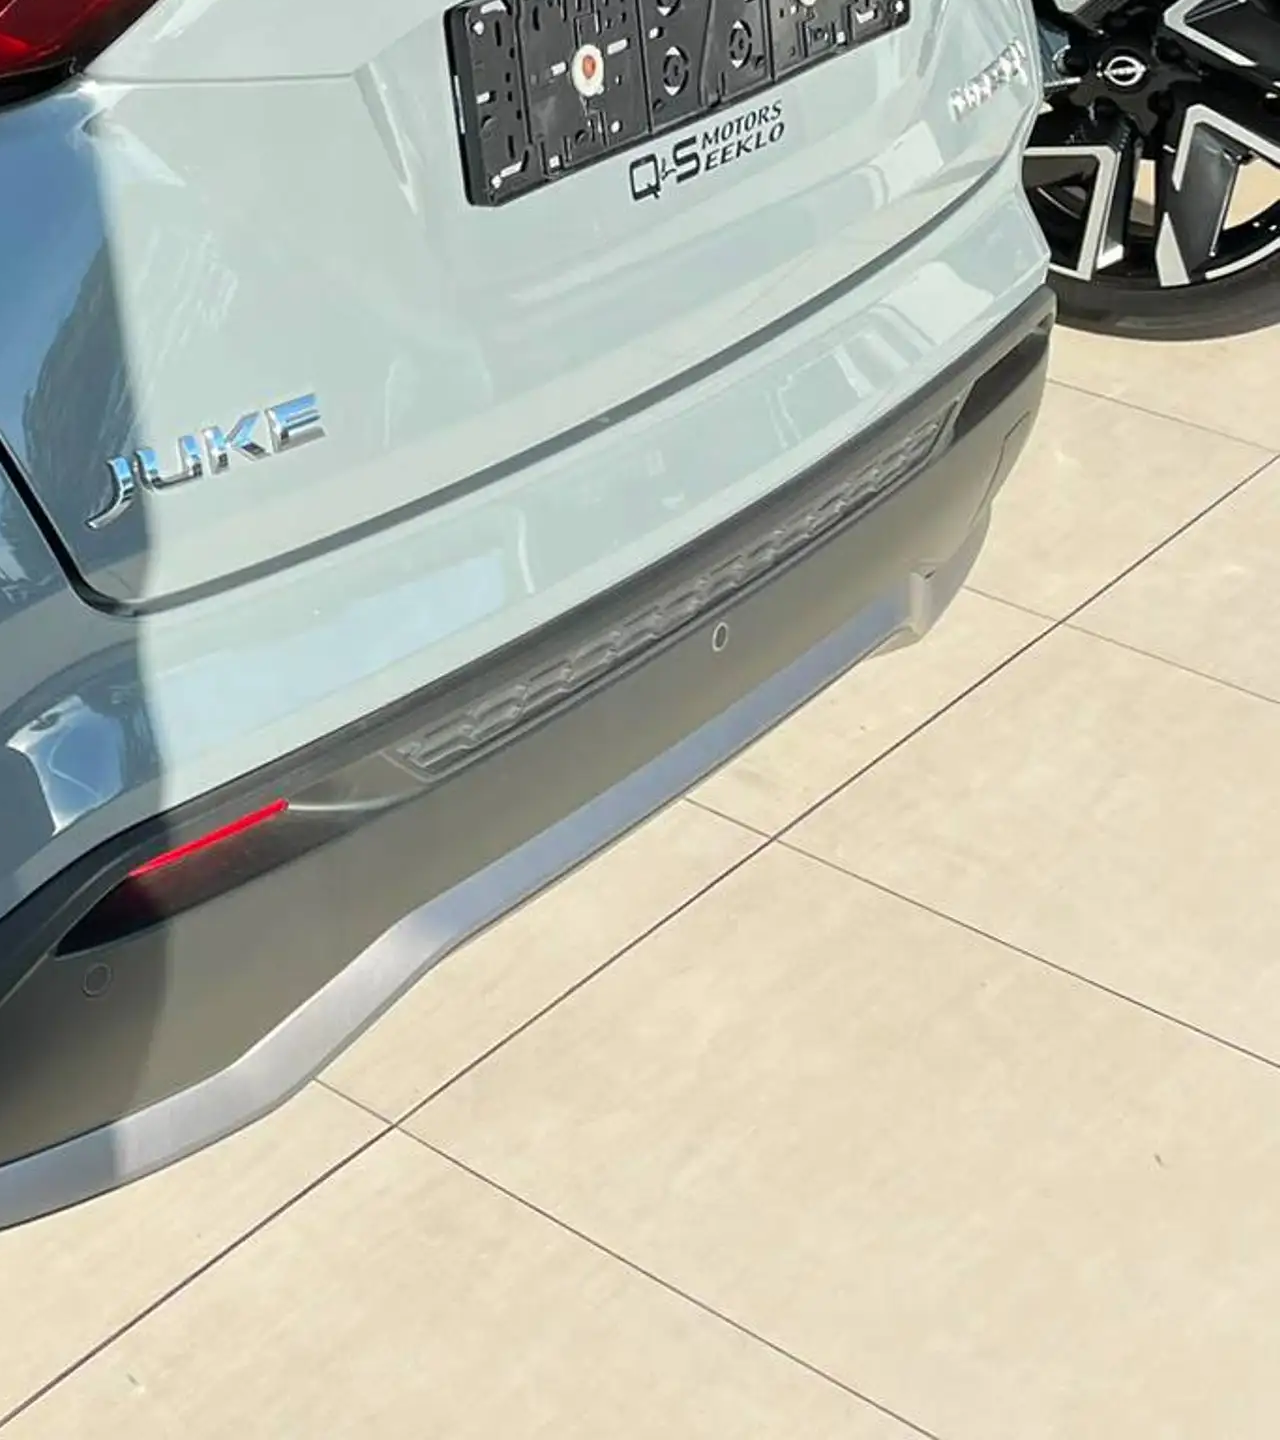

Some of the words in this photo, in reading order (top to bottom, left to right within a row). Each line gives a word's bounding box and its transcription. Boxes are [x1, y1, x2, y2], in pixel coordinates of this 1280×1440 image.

[701, 99, 782, 150] MOTORS
[705, 121, 785, 171] EEKLO
[85, 393, 326, 529] JUKE
